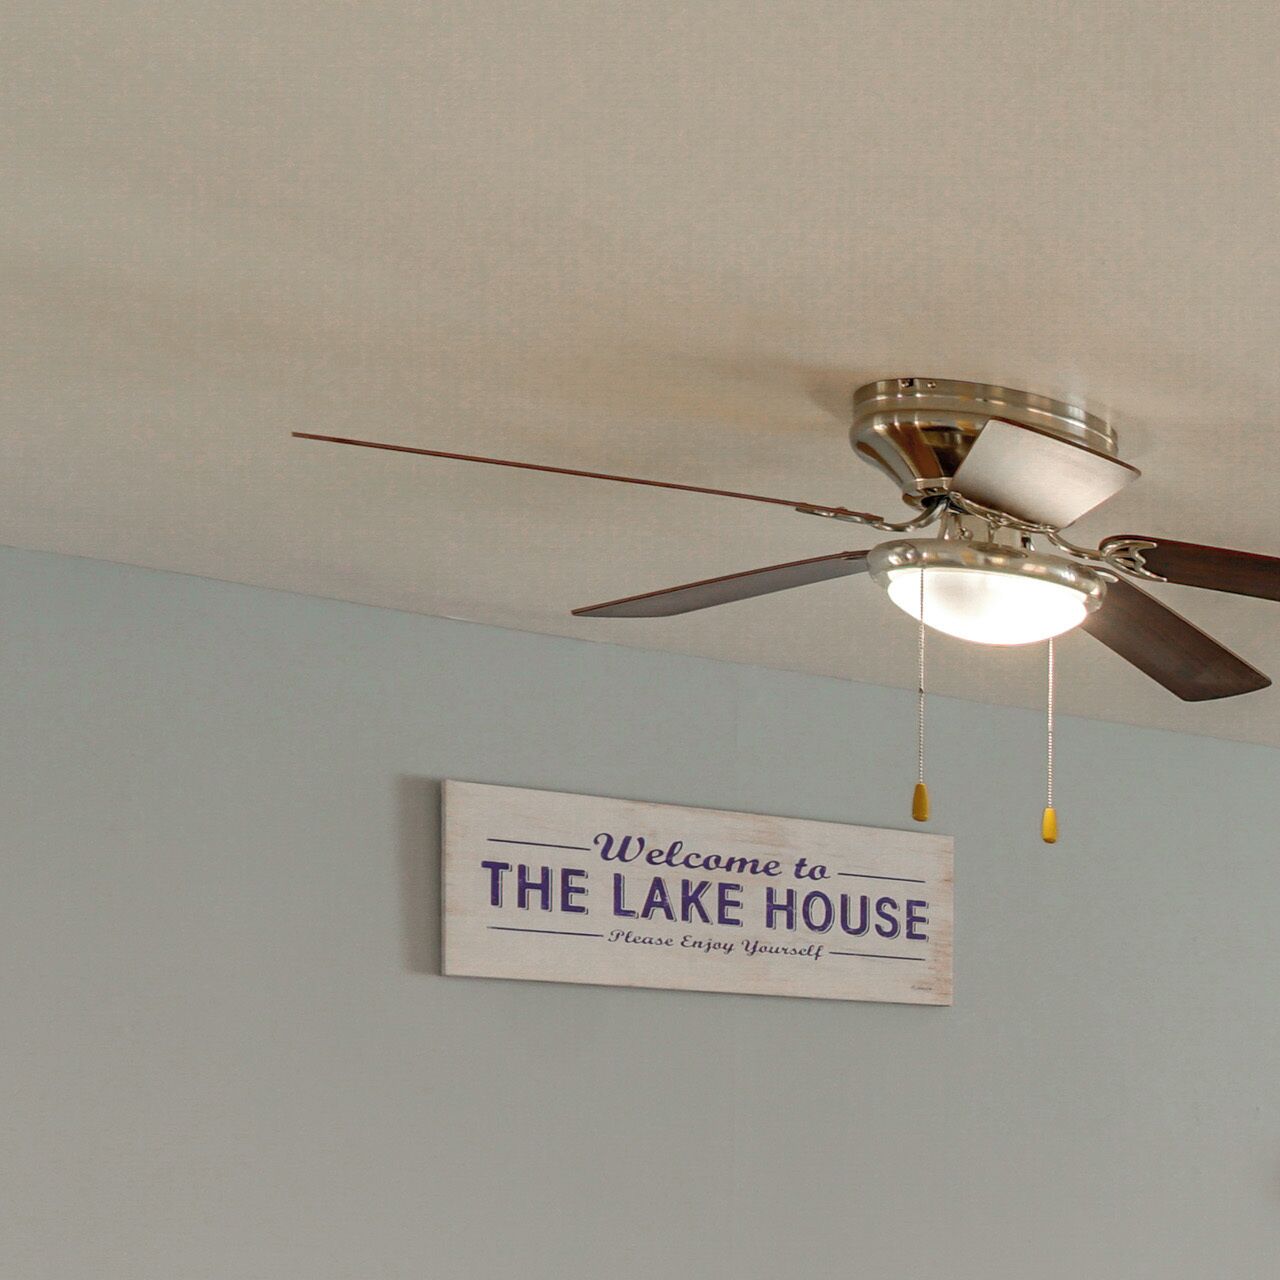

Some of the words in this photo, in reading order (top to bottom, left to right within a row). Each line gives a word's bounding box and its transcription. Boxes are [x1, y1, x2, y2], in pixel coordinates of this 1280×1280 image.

[593, 832, 783, 877] Welcome
[793, 857, 831, 881] to
[481, 860, 589, 915] THE
[613, 872, 743, 927] LAKE
[765, 886, 929, 942] HOUSE
[608, 929, 674, 947] Please
[680, 935, 734, 955] Enjoy
[741, 939, 824, 961] Yourself
